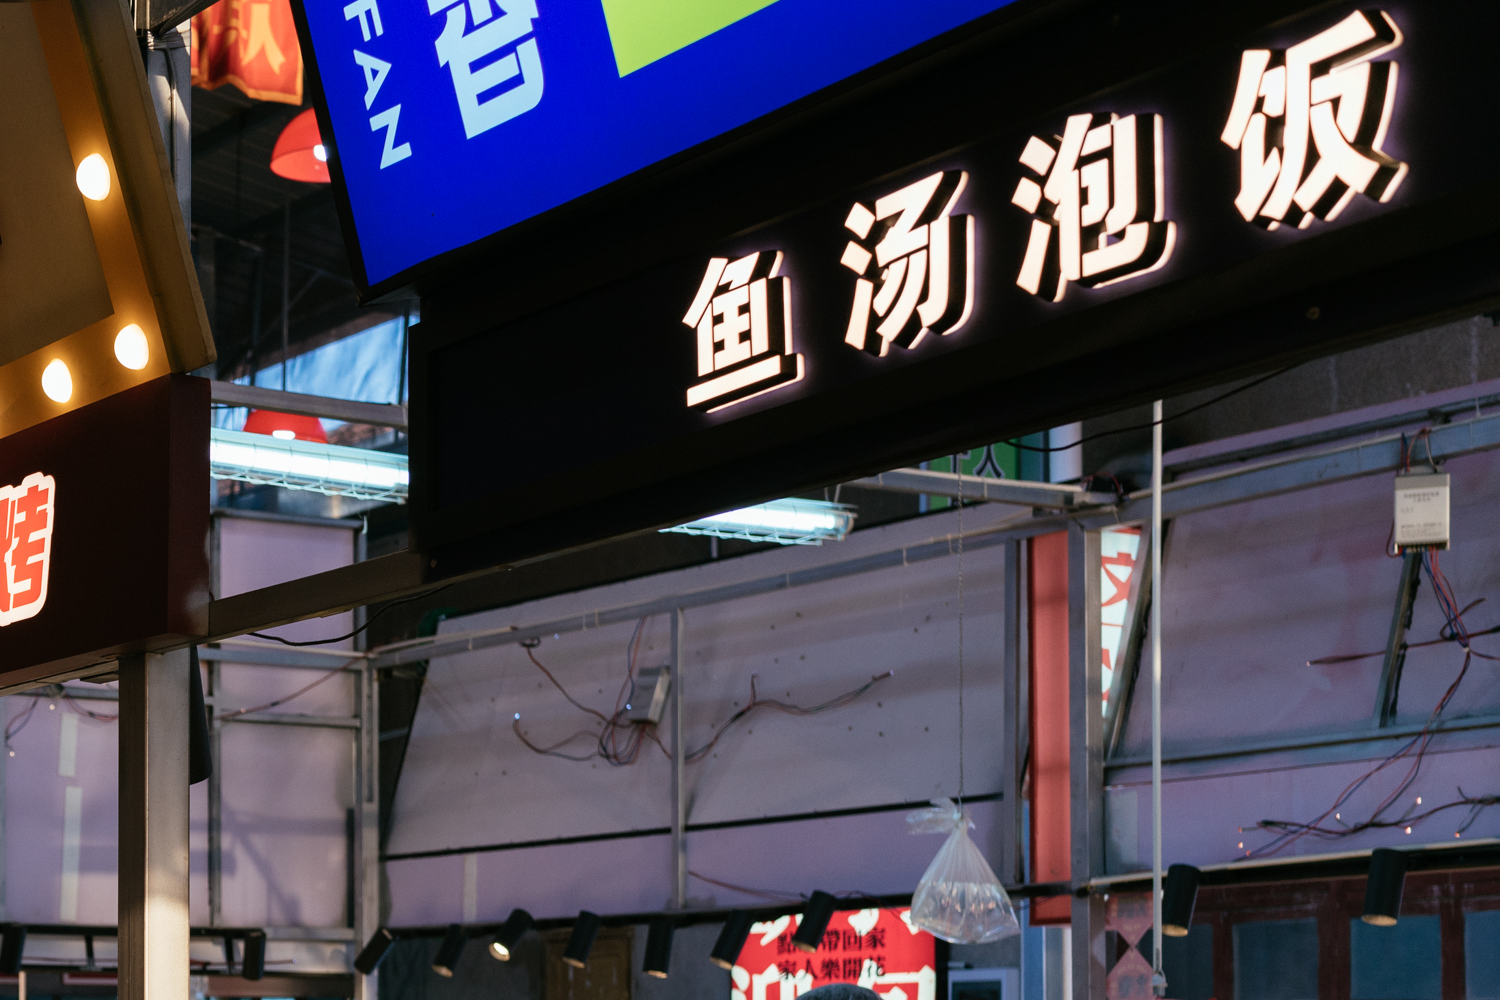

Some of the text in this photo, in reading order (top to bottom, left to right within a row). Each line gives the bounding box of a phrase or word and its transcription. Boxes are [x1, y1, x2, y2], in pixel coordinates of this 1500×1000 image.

[343, 0, 413, 170] FAN
[682, 9, 1408, 414] 鱼汤泡饭
[777, 927, 886, 955] 點帶回家
